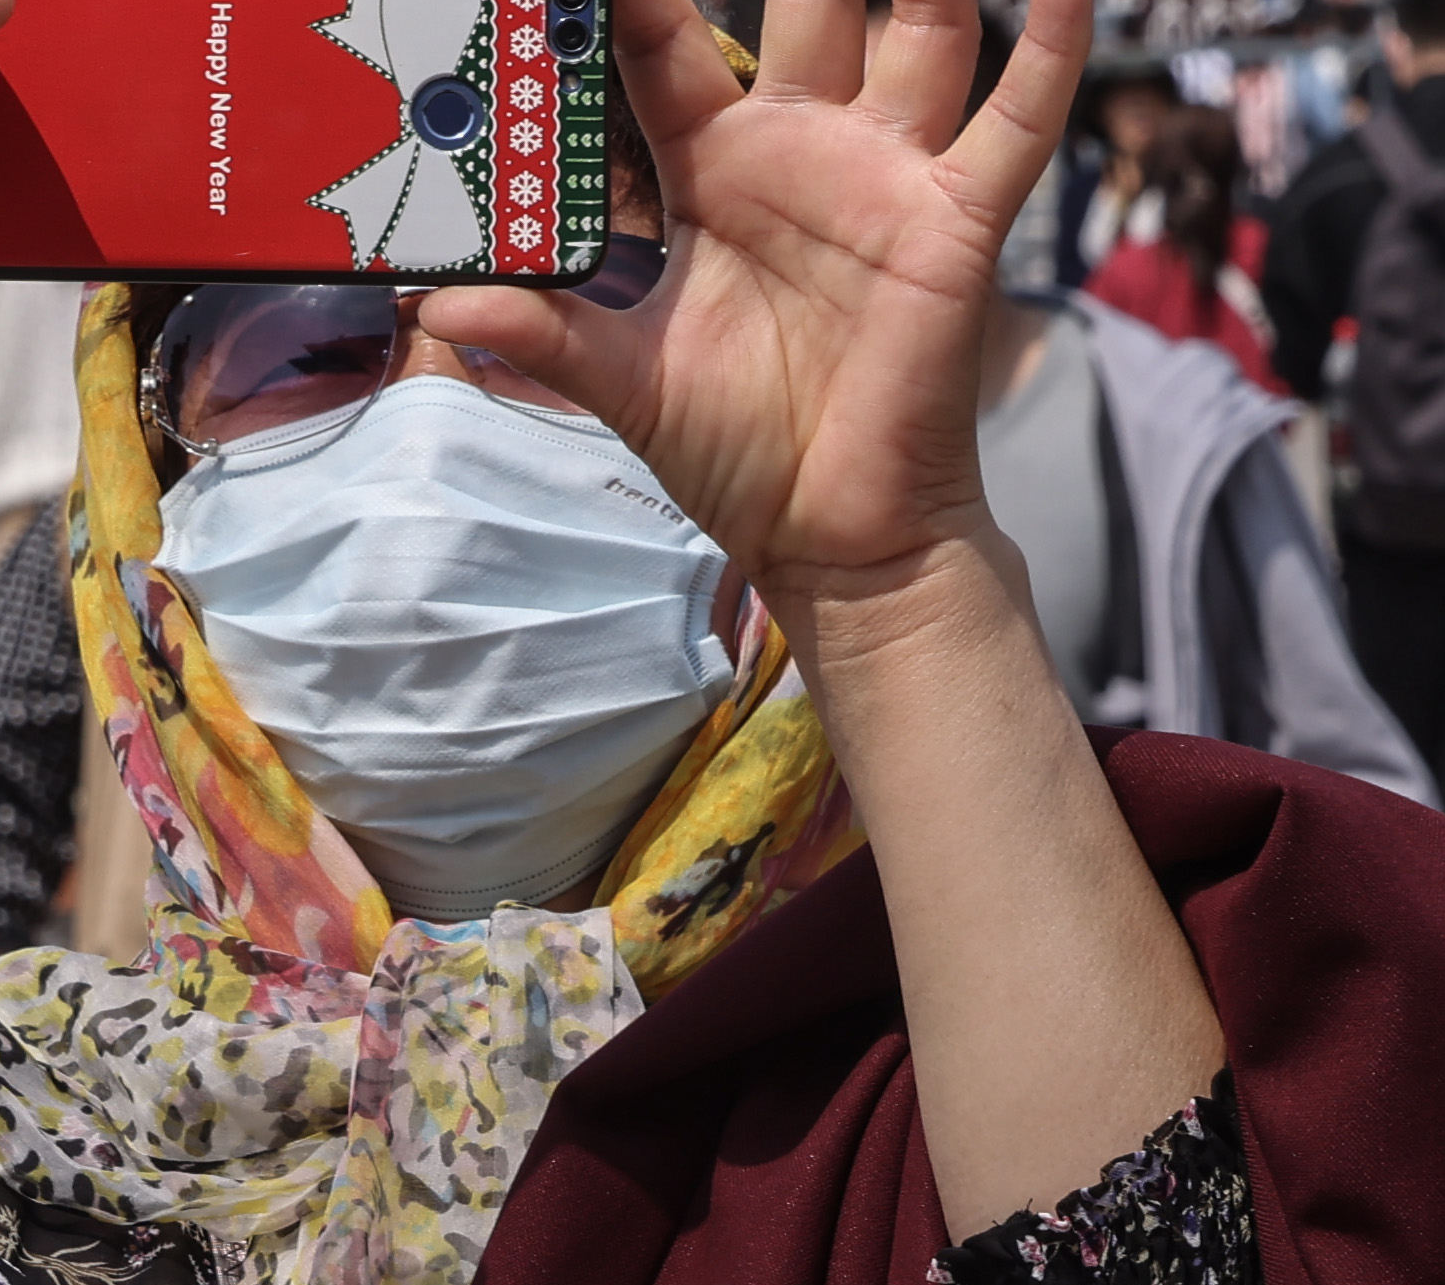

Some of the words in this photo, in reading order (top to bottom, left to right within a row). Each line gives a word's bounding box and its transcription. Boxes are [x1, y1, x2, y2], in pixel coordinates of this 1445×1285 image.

[204, 2, 234, 86] Happy
[208, 92, 233, 150] New
[208, 155, 232, 216] Year
